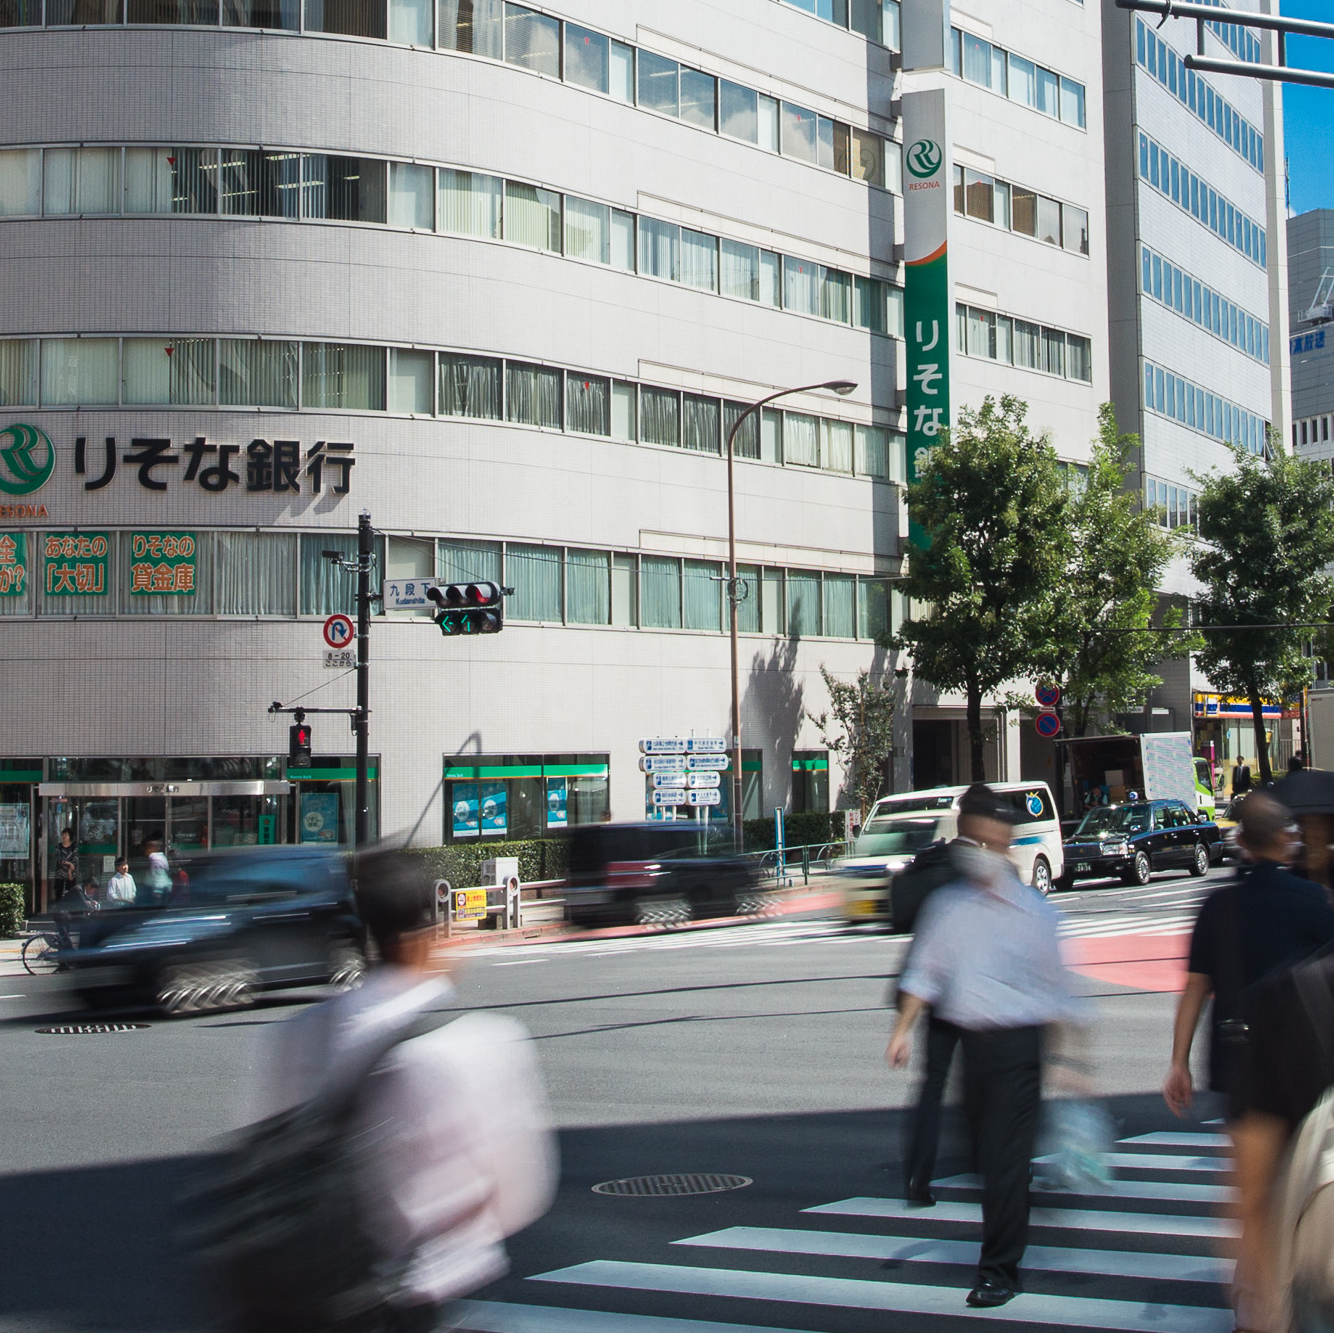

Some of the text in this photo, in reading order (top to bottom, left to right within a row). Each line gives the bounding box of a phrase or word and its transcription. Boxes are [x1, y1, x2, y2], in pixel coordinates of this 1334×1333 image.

[909, 180, 941, 191] RESONA
[75, 436, 356, 494] りそな銀行
[46, 535, 107, 558] あなたの
[132, 535, 195, 558] りそなの
[46, 563, 105, 593] 「大切」
[132, 563, 195, 593] 貸金庫
[389, 582, 431, 597] 九段下
[395, 598, 426, 606] Kudanshita
[324, 660, 352, 668] ここから
